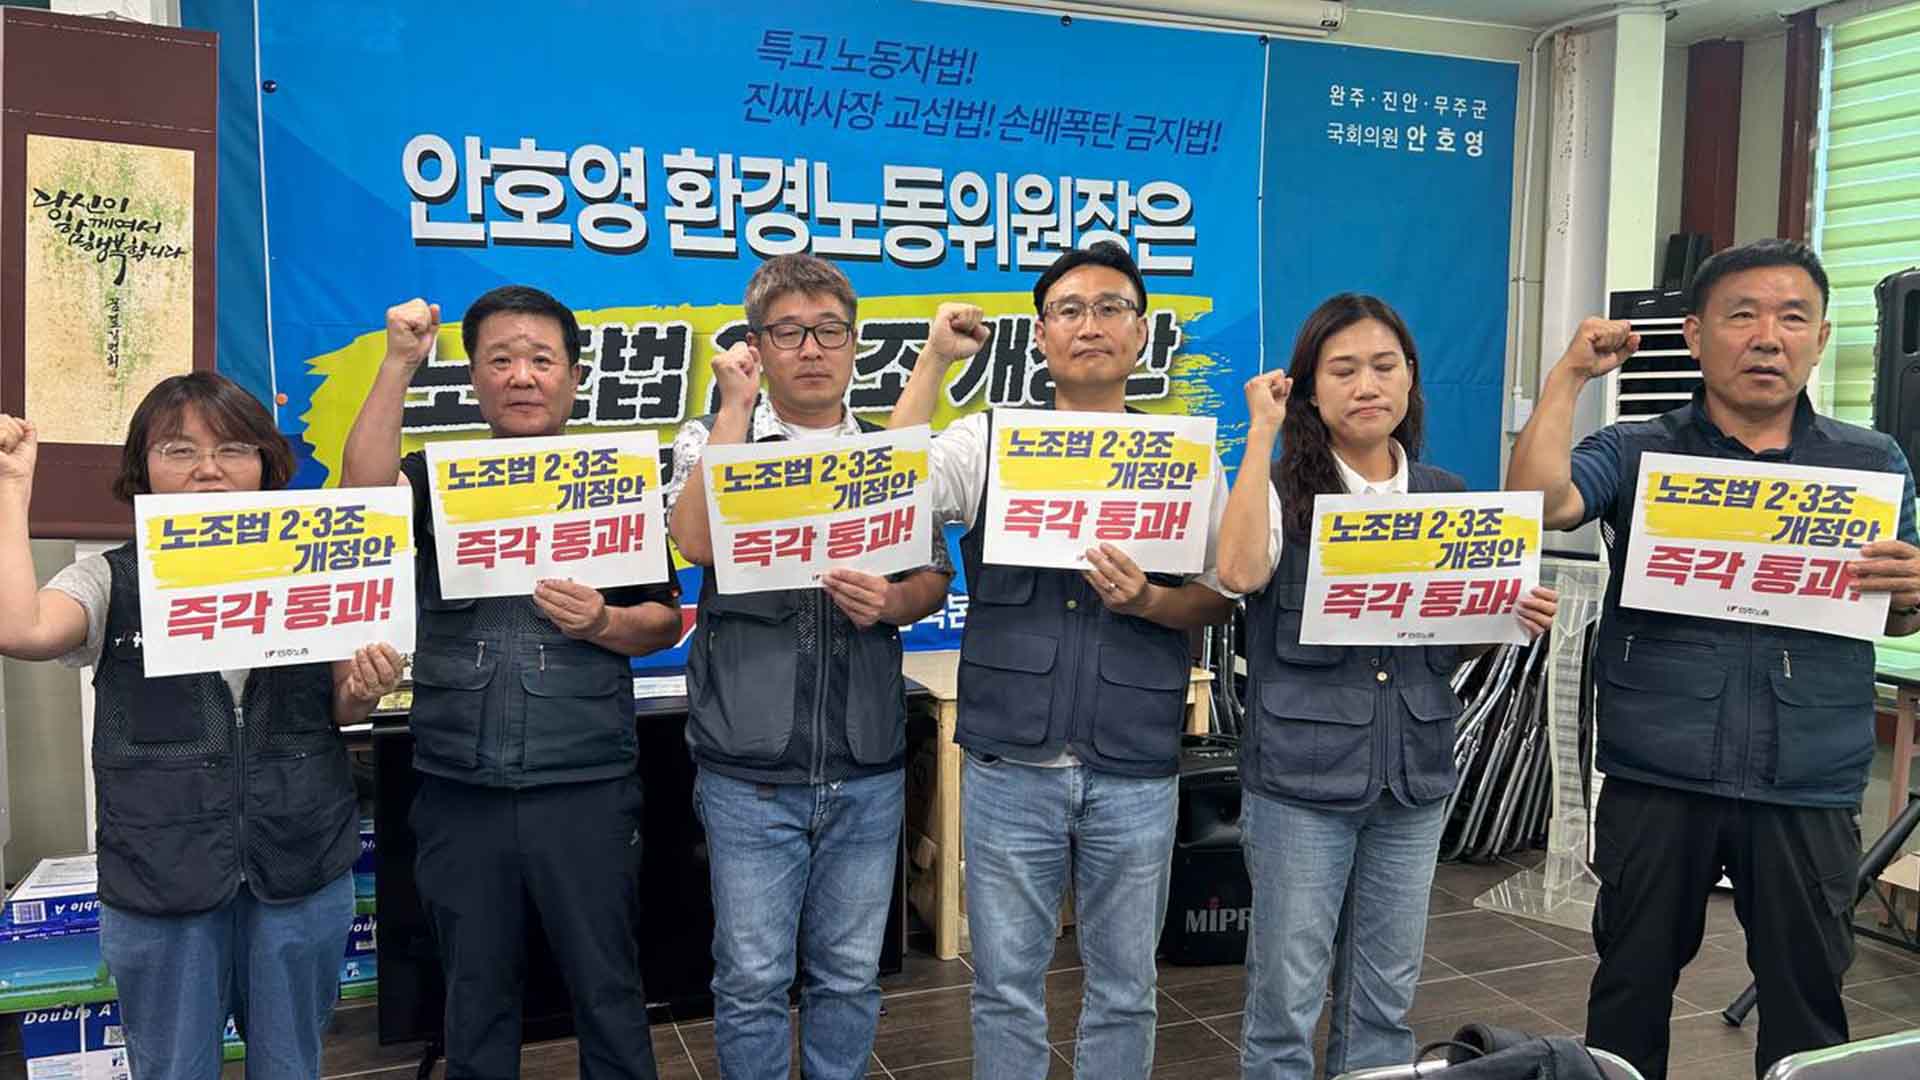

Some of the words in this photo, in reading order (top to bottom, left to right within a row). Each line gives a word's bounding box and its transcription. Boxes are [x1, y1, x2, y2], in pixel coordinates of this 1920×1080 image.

[756, 30, 828, 70] 특고
[831, 38, 978, 86] 노동자법!
[744, 83, 883, 130] 진짜사장
[885, 96, 996, 139] 교섭법!
[999, 104, 1122, 149] 손배폭탄
[1126, 114, 1223, 155] 금지법!
[1327, 122, 1400, 149] 국회의원
[402, 133, 650, 251] 안호영
[662, 147, 1198, 276] 환경노동위원장은
[400, 321, 693, 433] 노법
[1007, 430, 1094, 458] 노조법
[447, 455, 537, 490] 노조법
[723, 458, 813, 493] 노조법
[832, 470, 918, 510] 개정안
[1106, 461, 1198, 490] 개정안
[556, 475, 646, 511] 개정안
[1655, 475, 1760, 509] 노조법
[160, 511, 271, 550] 노조법
[733, 526, 817, 567] 즉각
[826, 505, 916, 560] 통과!
[1004, 499, 1088, 539] 즉각
[1094, 501, 1192, 540] 통과!
[1329, 512, 1423, 542] 노조법
[1771, 515, 1880, 549] 개정안
[292, 535, 396, 573] 개정안
[456, 526, 541, 569] 즉각
[551, 513, 646, 562] 통과!
[1434, 537, 1525, 570] 개정안
[1646, 546, 1745, 590] 즉각
[1751, 553, 1862, 601] 통과
[167, 590, 273, 640] 즉각
[283, 577, 395, 631] 통과!
[1322, 582, 1414, 619] 즉각
[1419, 578, 1522, 618] 통과!
[1185, 907, 1252, 932] MIPR
[24, 1007, 92, 1025] Double
[98, 1003, 112, 1018] A
